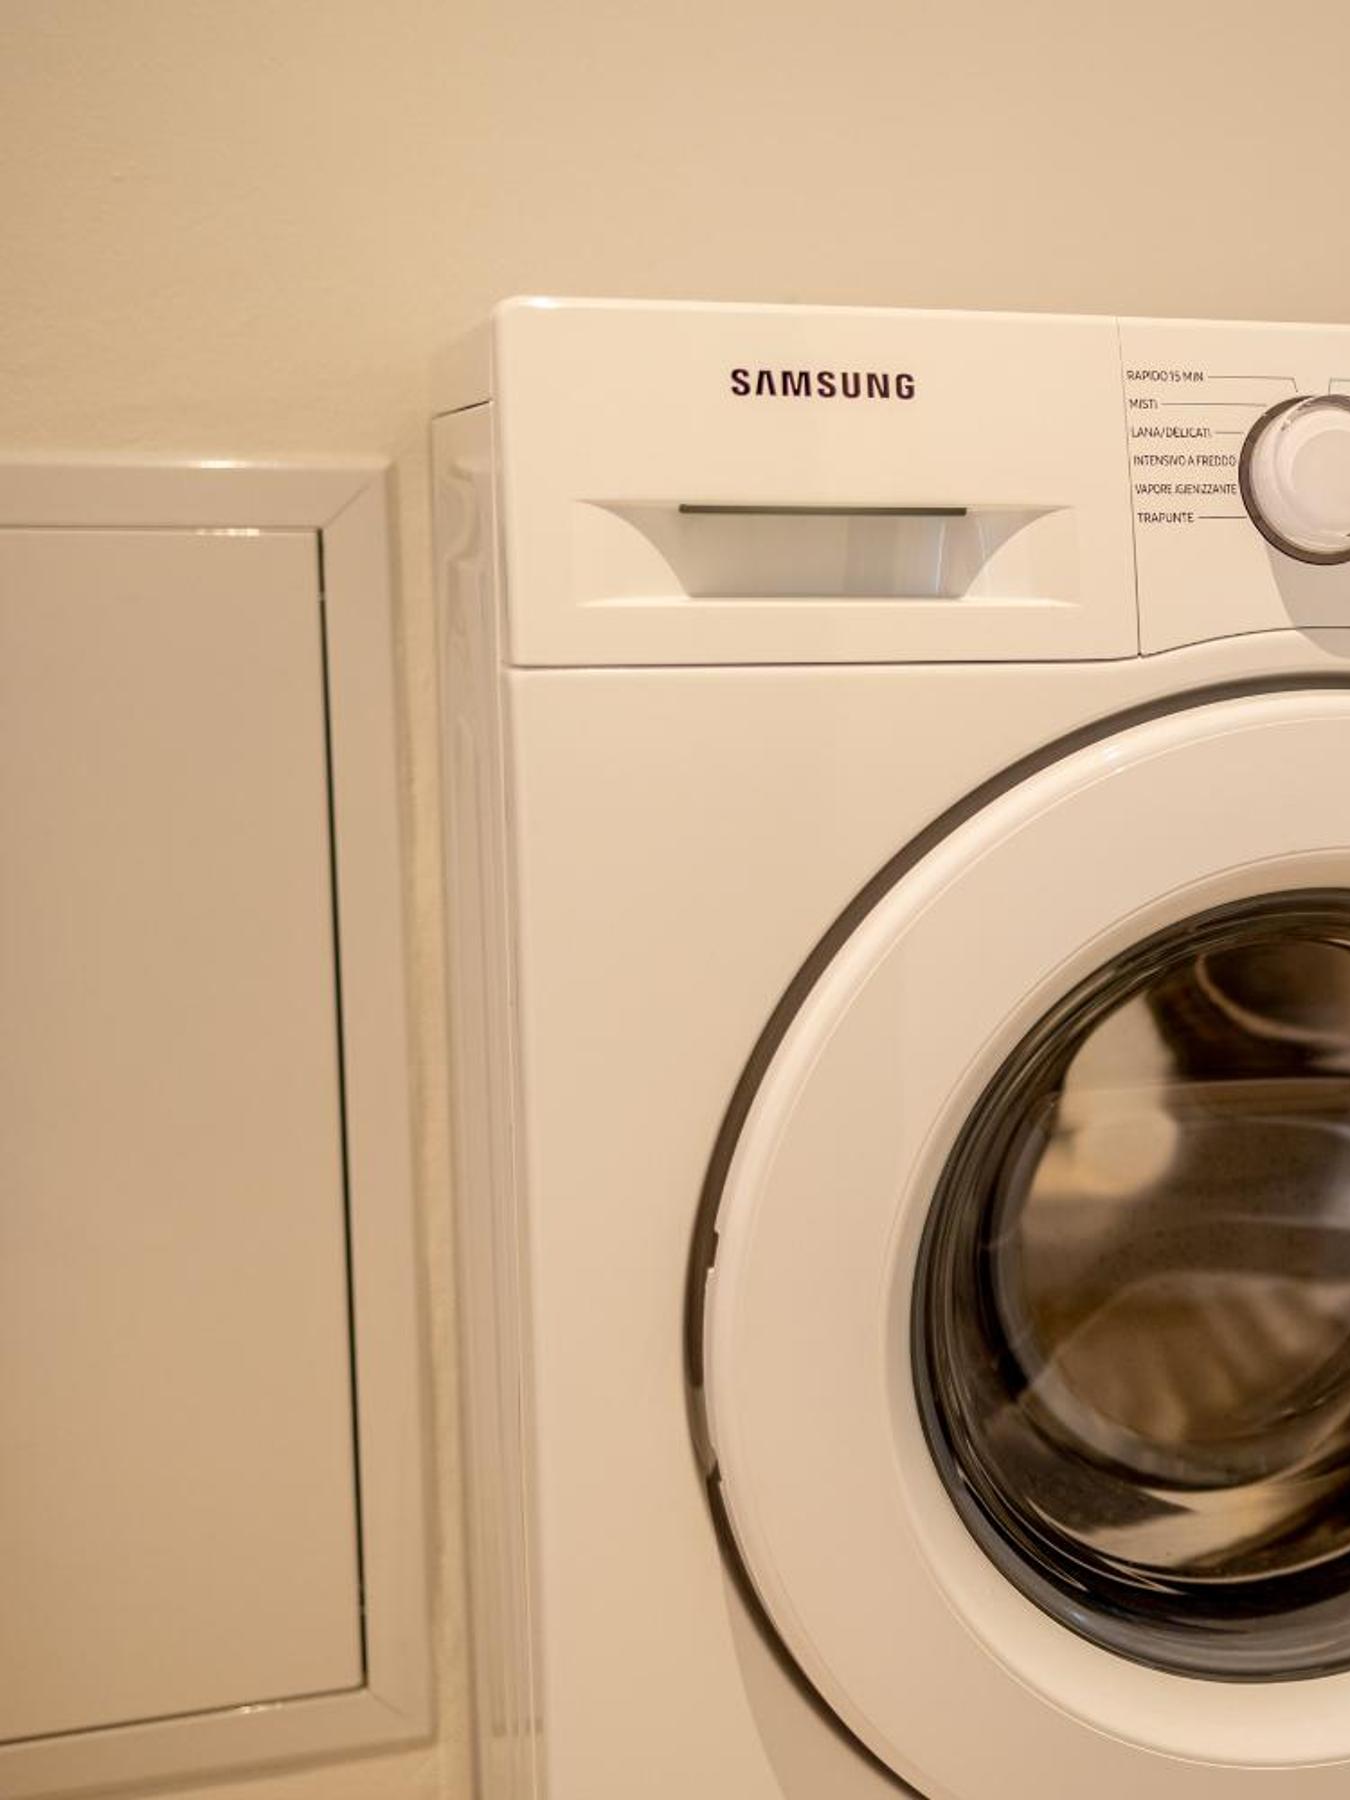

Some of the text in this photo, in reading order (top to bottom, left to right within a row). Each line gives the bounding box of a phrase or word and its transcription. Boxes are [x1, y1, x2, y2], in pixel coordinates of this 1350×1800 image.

[1126, 370, 1168, 381] RAPIDO
[731, 368, 915, 400] SAMSUNG
[1129, 398, 1158, 409] MISTI
[1131, 426, 1213, 438] LANA/DELICATI
[1133, 455, 1186, 467] INTENSIVO
[1196, 455, 1237, 467] FREDDO
[1135, 483, 1172, 494] VAPORE
[1137, 512, 1194, 523] TRAPUNTE
